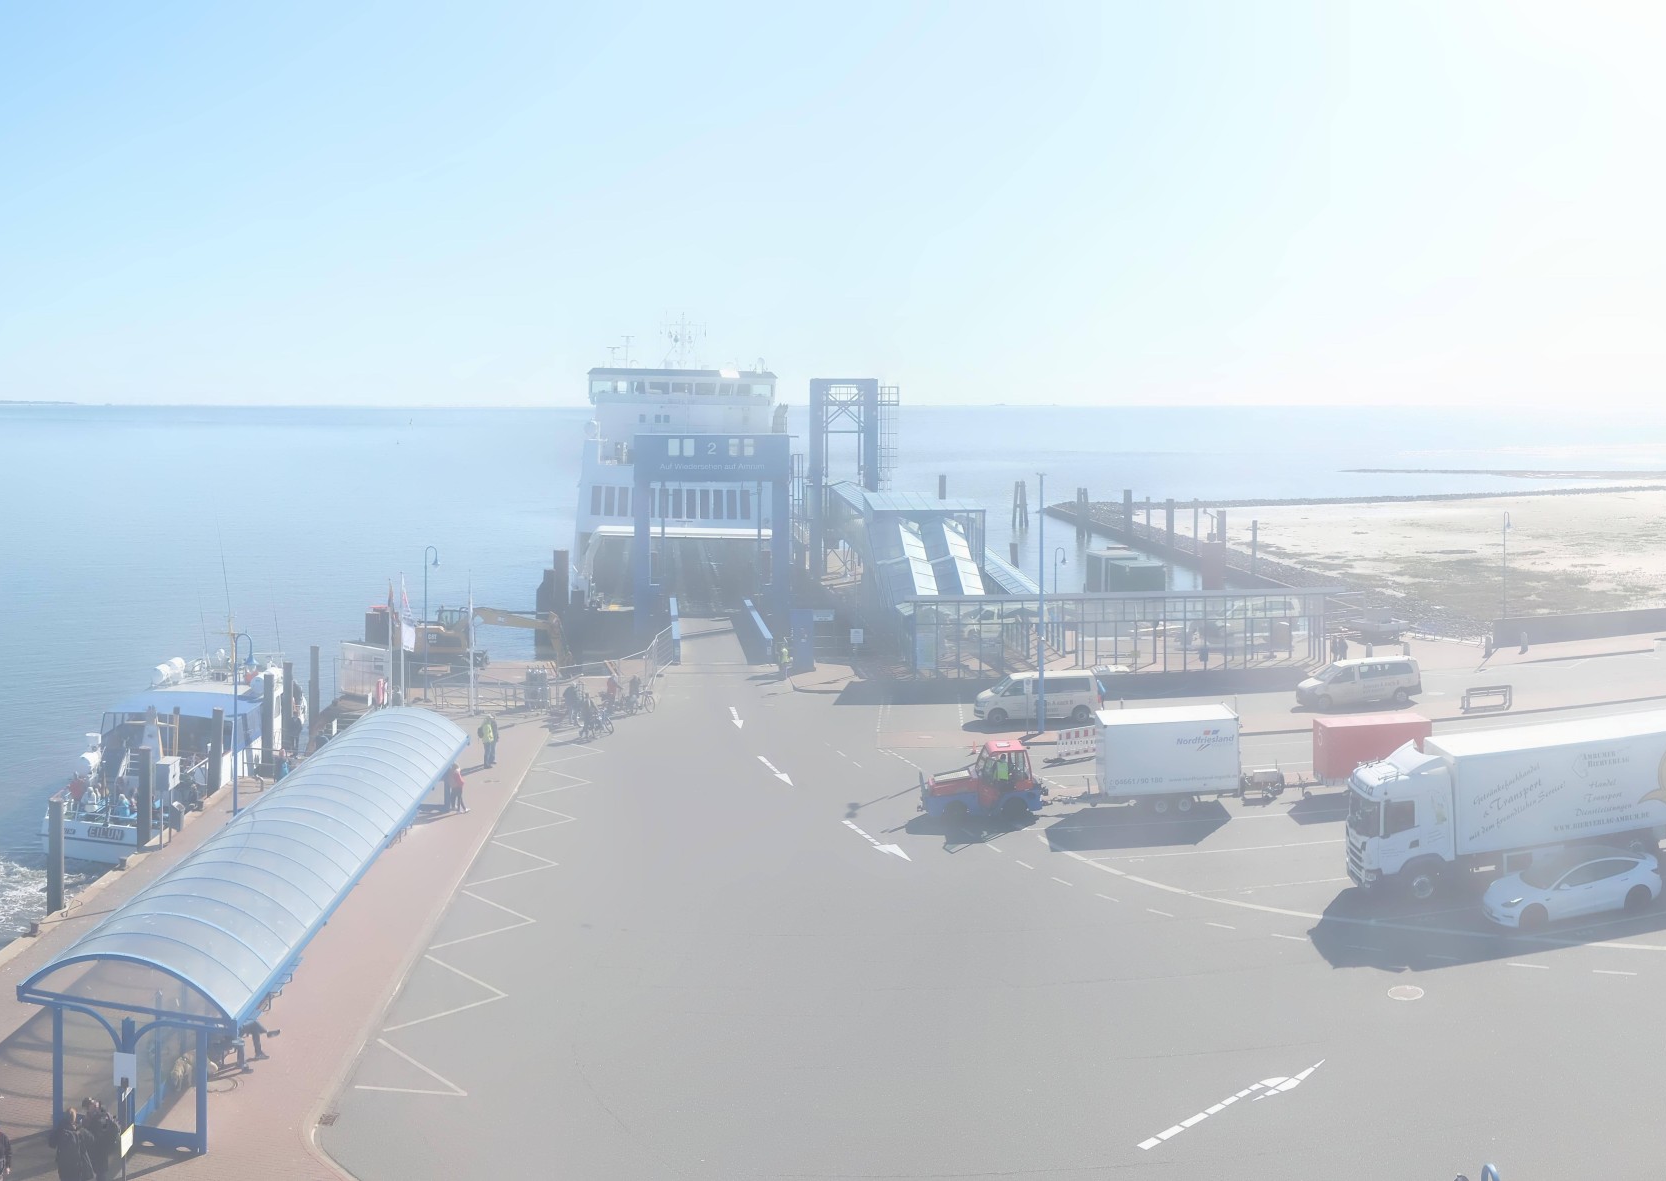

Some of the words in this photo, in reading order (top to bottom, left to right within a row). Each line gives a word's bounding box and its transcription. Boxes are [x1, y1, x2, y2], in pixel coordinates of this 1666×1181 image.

[707, 442, 717, 455] 2
[1176, 734, 1235, 745] Nordfriesland
[1489, 777, 1542, 811] Transport
